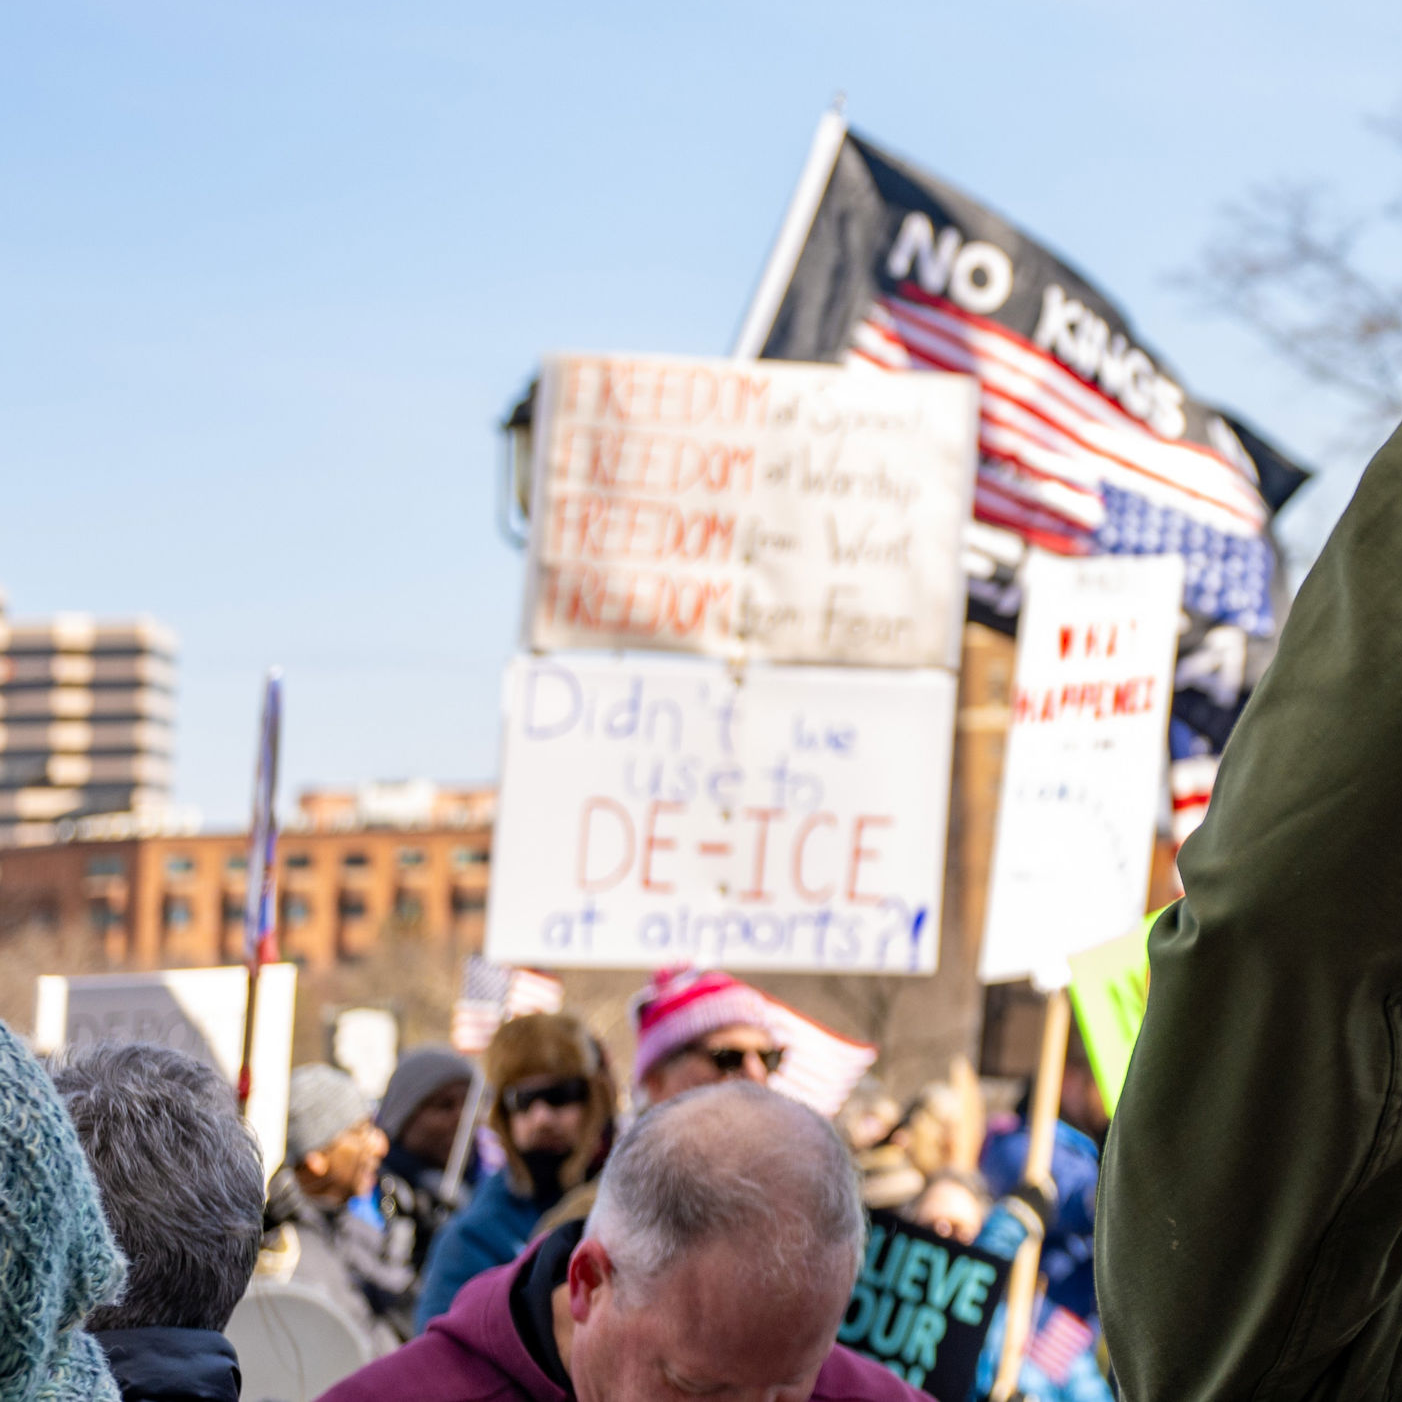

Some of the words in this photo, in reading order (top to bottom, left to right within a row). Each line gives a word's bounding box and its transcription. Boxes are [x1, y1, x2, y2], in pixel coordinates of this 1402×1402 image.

[887, 210, 1013, 315] NO
[1034, 283, 1187, 439] KINGS
[561, 359, 770, 428] FREEDOM
[556, 424, 755, 495] FREEDOM
[548, 492, 737, 563] FREEDOM
[539, 561, 734, 638] FREEDOM
[818, 582, 916, 645] Fear
[523, 661, 740, 755] Didn't
[623, 755, 746, 806] use
[765, 753, 826, 812] to
[576, 794, 896, 907] DE-ICE
[541, 900, 607, 950] at
[863, 1225, 998, 1326] LIEVE
